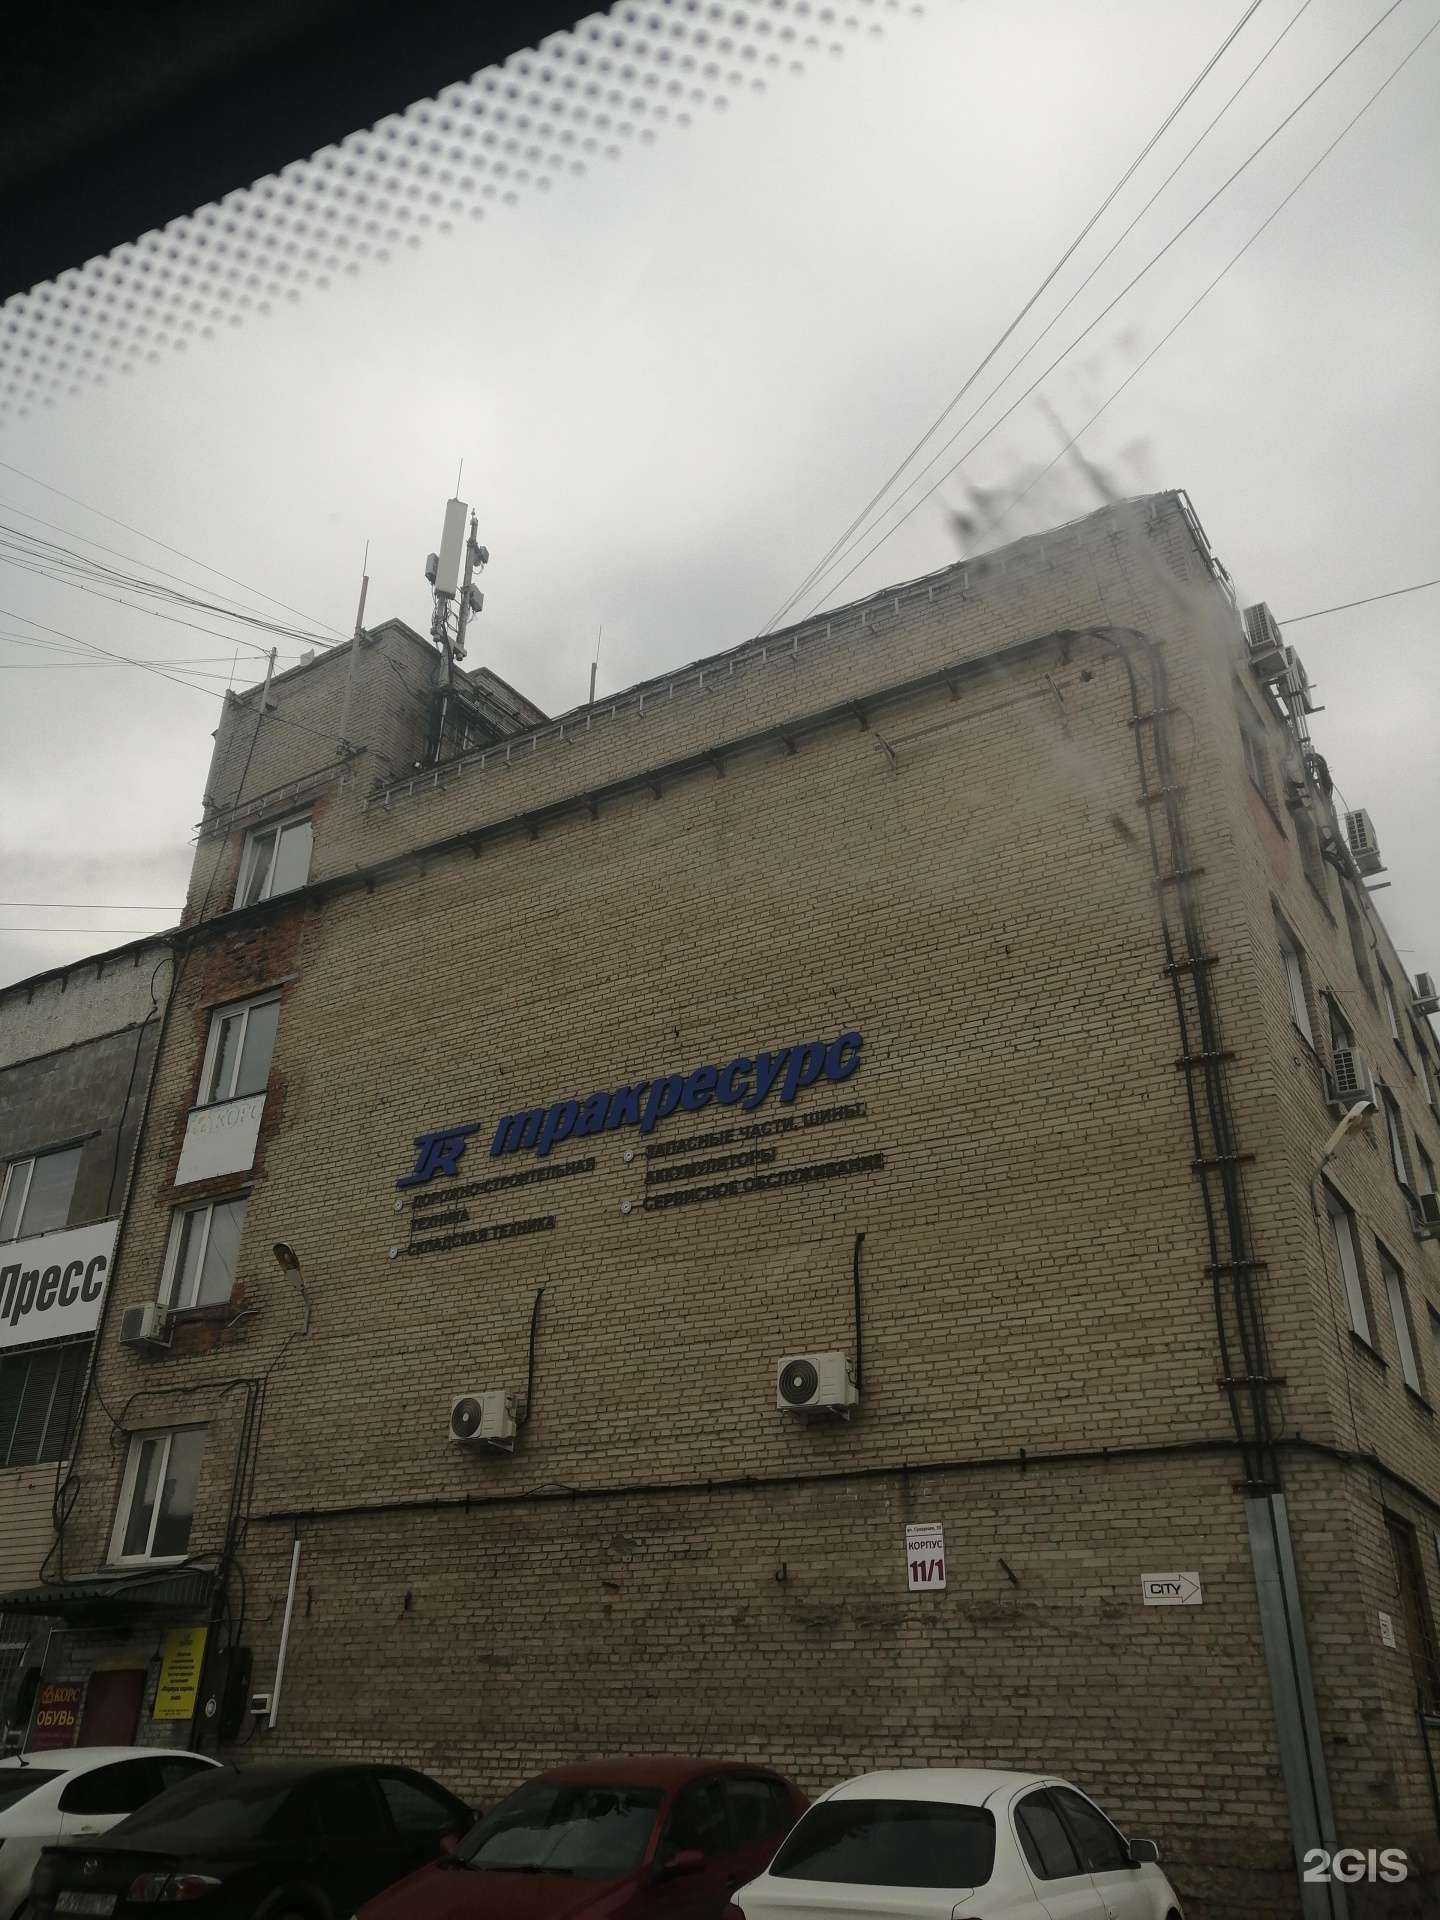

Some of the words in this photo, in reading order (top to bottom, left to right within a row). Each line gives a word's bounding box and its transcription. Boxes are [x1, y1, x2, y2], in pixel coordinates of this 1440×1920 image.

[490, 1031, 865, 1158] тракресурс
[0, 1255, 107, 1327] Пресс
[908, 1540, 943, 1551] КОРПУС
[909, 1559, 945, 1582] 11/1
[1150, 1583, 1181, 1595] CITY
[37, 1709, 76, 1728] ОБУВЬ
